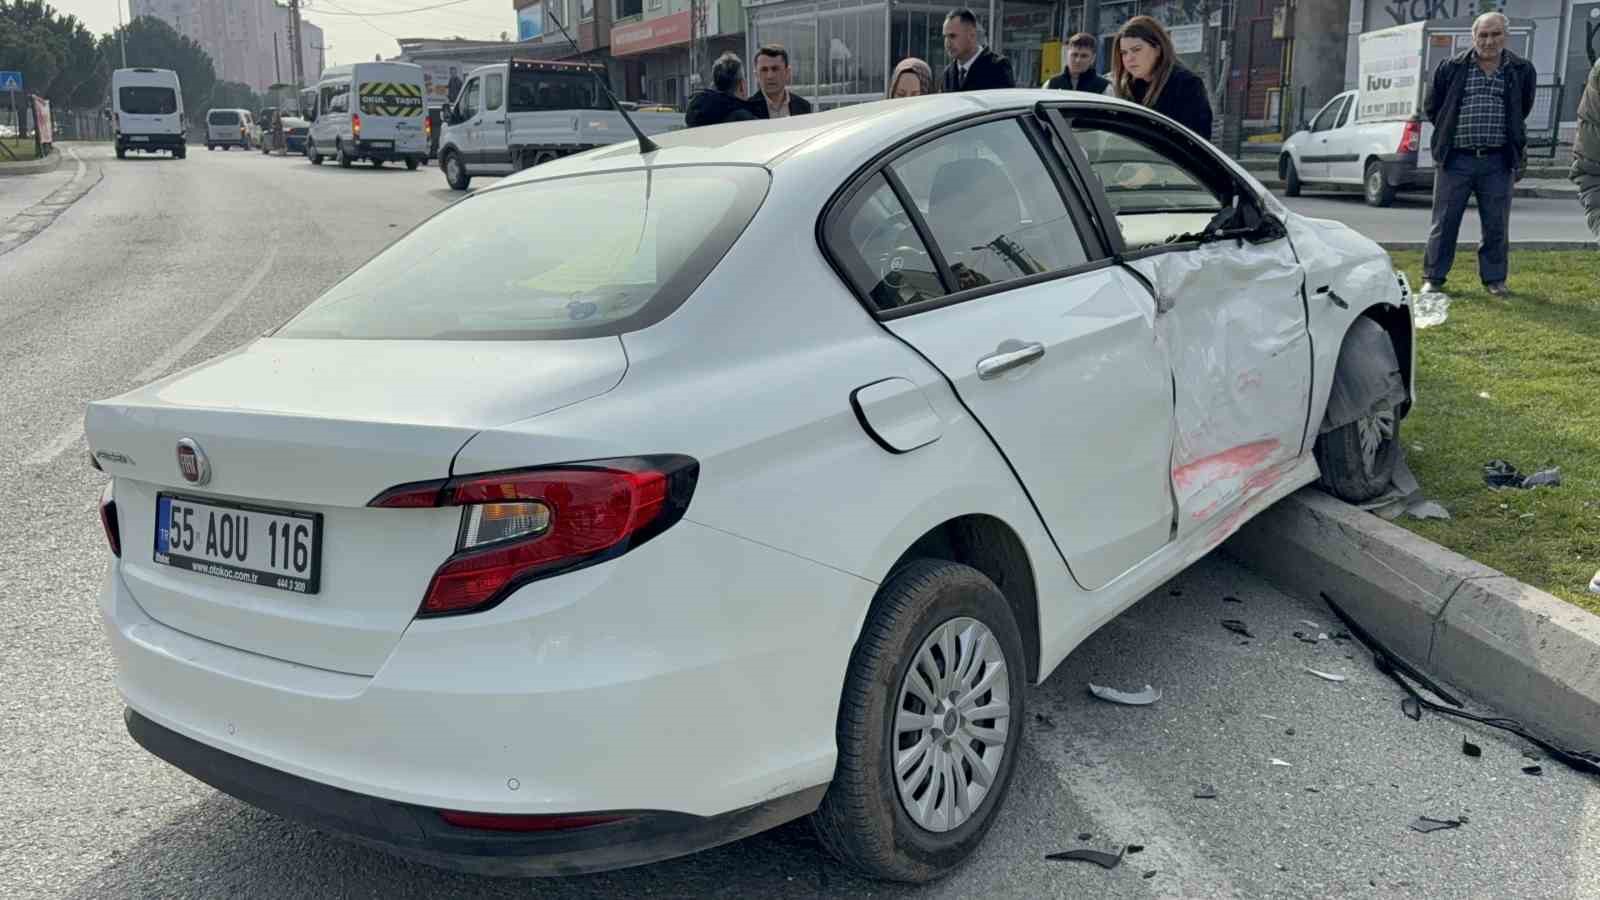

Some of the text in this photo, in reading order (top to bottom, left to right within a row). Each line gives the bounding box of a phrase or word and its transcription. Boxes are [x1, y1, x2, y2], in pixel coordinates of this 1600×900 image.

[170, 506, 309, 573] 55 AOU 116
[192, 562, 259, 583] www.otokoc.com.tr
